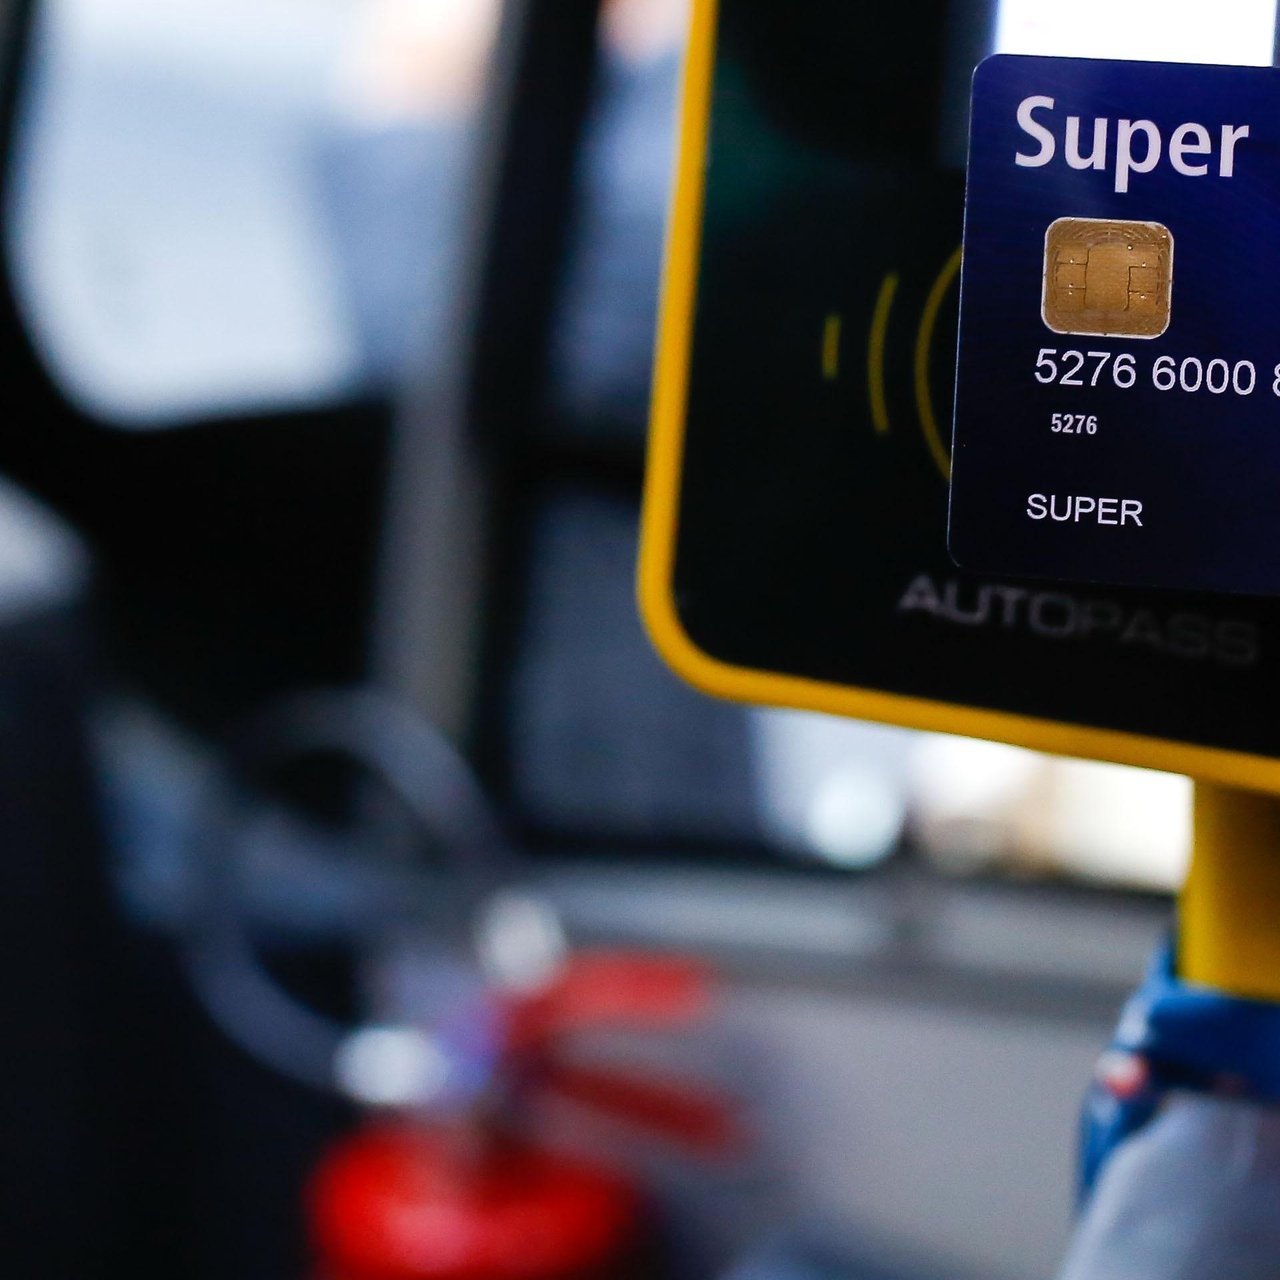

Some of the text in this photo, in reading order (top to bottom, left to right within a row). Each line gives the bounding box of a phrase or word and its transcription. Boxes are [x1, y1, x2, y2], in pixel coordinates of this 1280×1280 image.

[1014, 95, 1250, 194] Super
[1033, 348, 1137, 389] 5276
[1151, 354, 1257, 396] 6000
[1049, 412, 1098, 436] 5276
[1025, 492, 1144, 528] SUPER
[897, 573, 1258, 665] AUTOPASS
